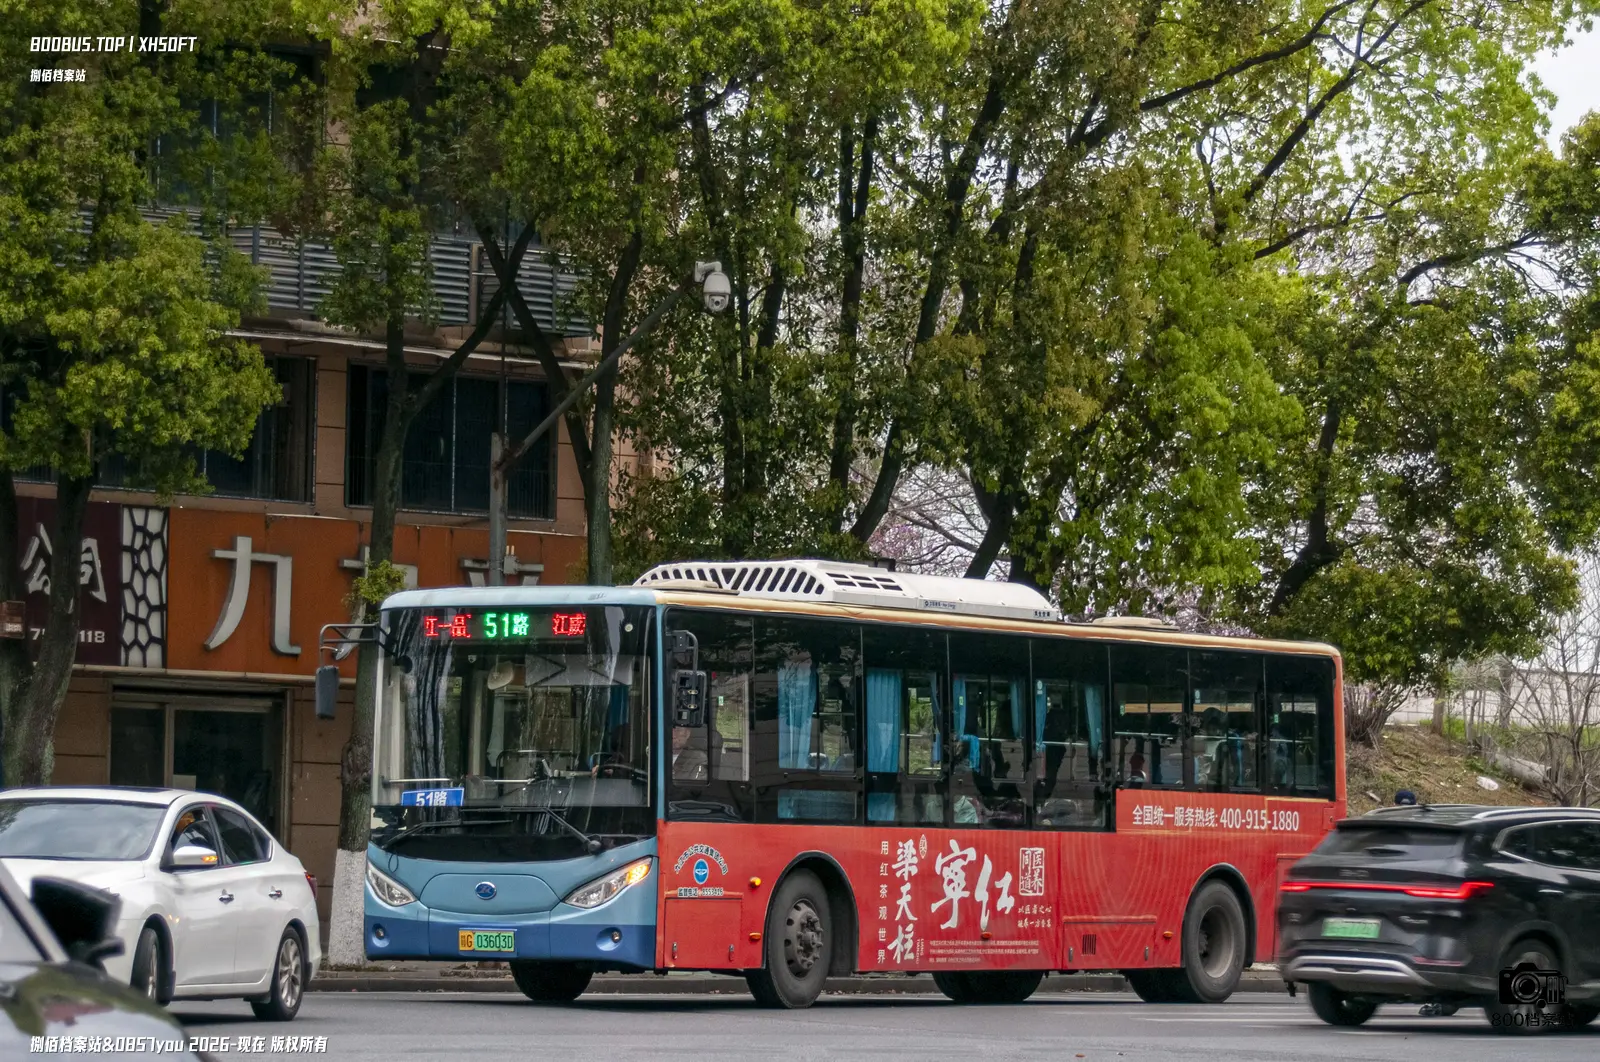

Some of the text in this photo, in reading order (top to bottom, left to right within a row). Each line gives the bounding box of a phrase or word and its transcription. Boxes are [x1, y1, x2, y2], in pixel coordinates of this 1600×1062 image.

[484, 613, 529, 638] 51路
[415, 790, 448, 807] 51路
[1219, 807, 1299, 831] 400-915-1880
[877, 840, 889, 964] 用红茶观世界
[887, 838, 919, 964] 梁天柱
